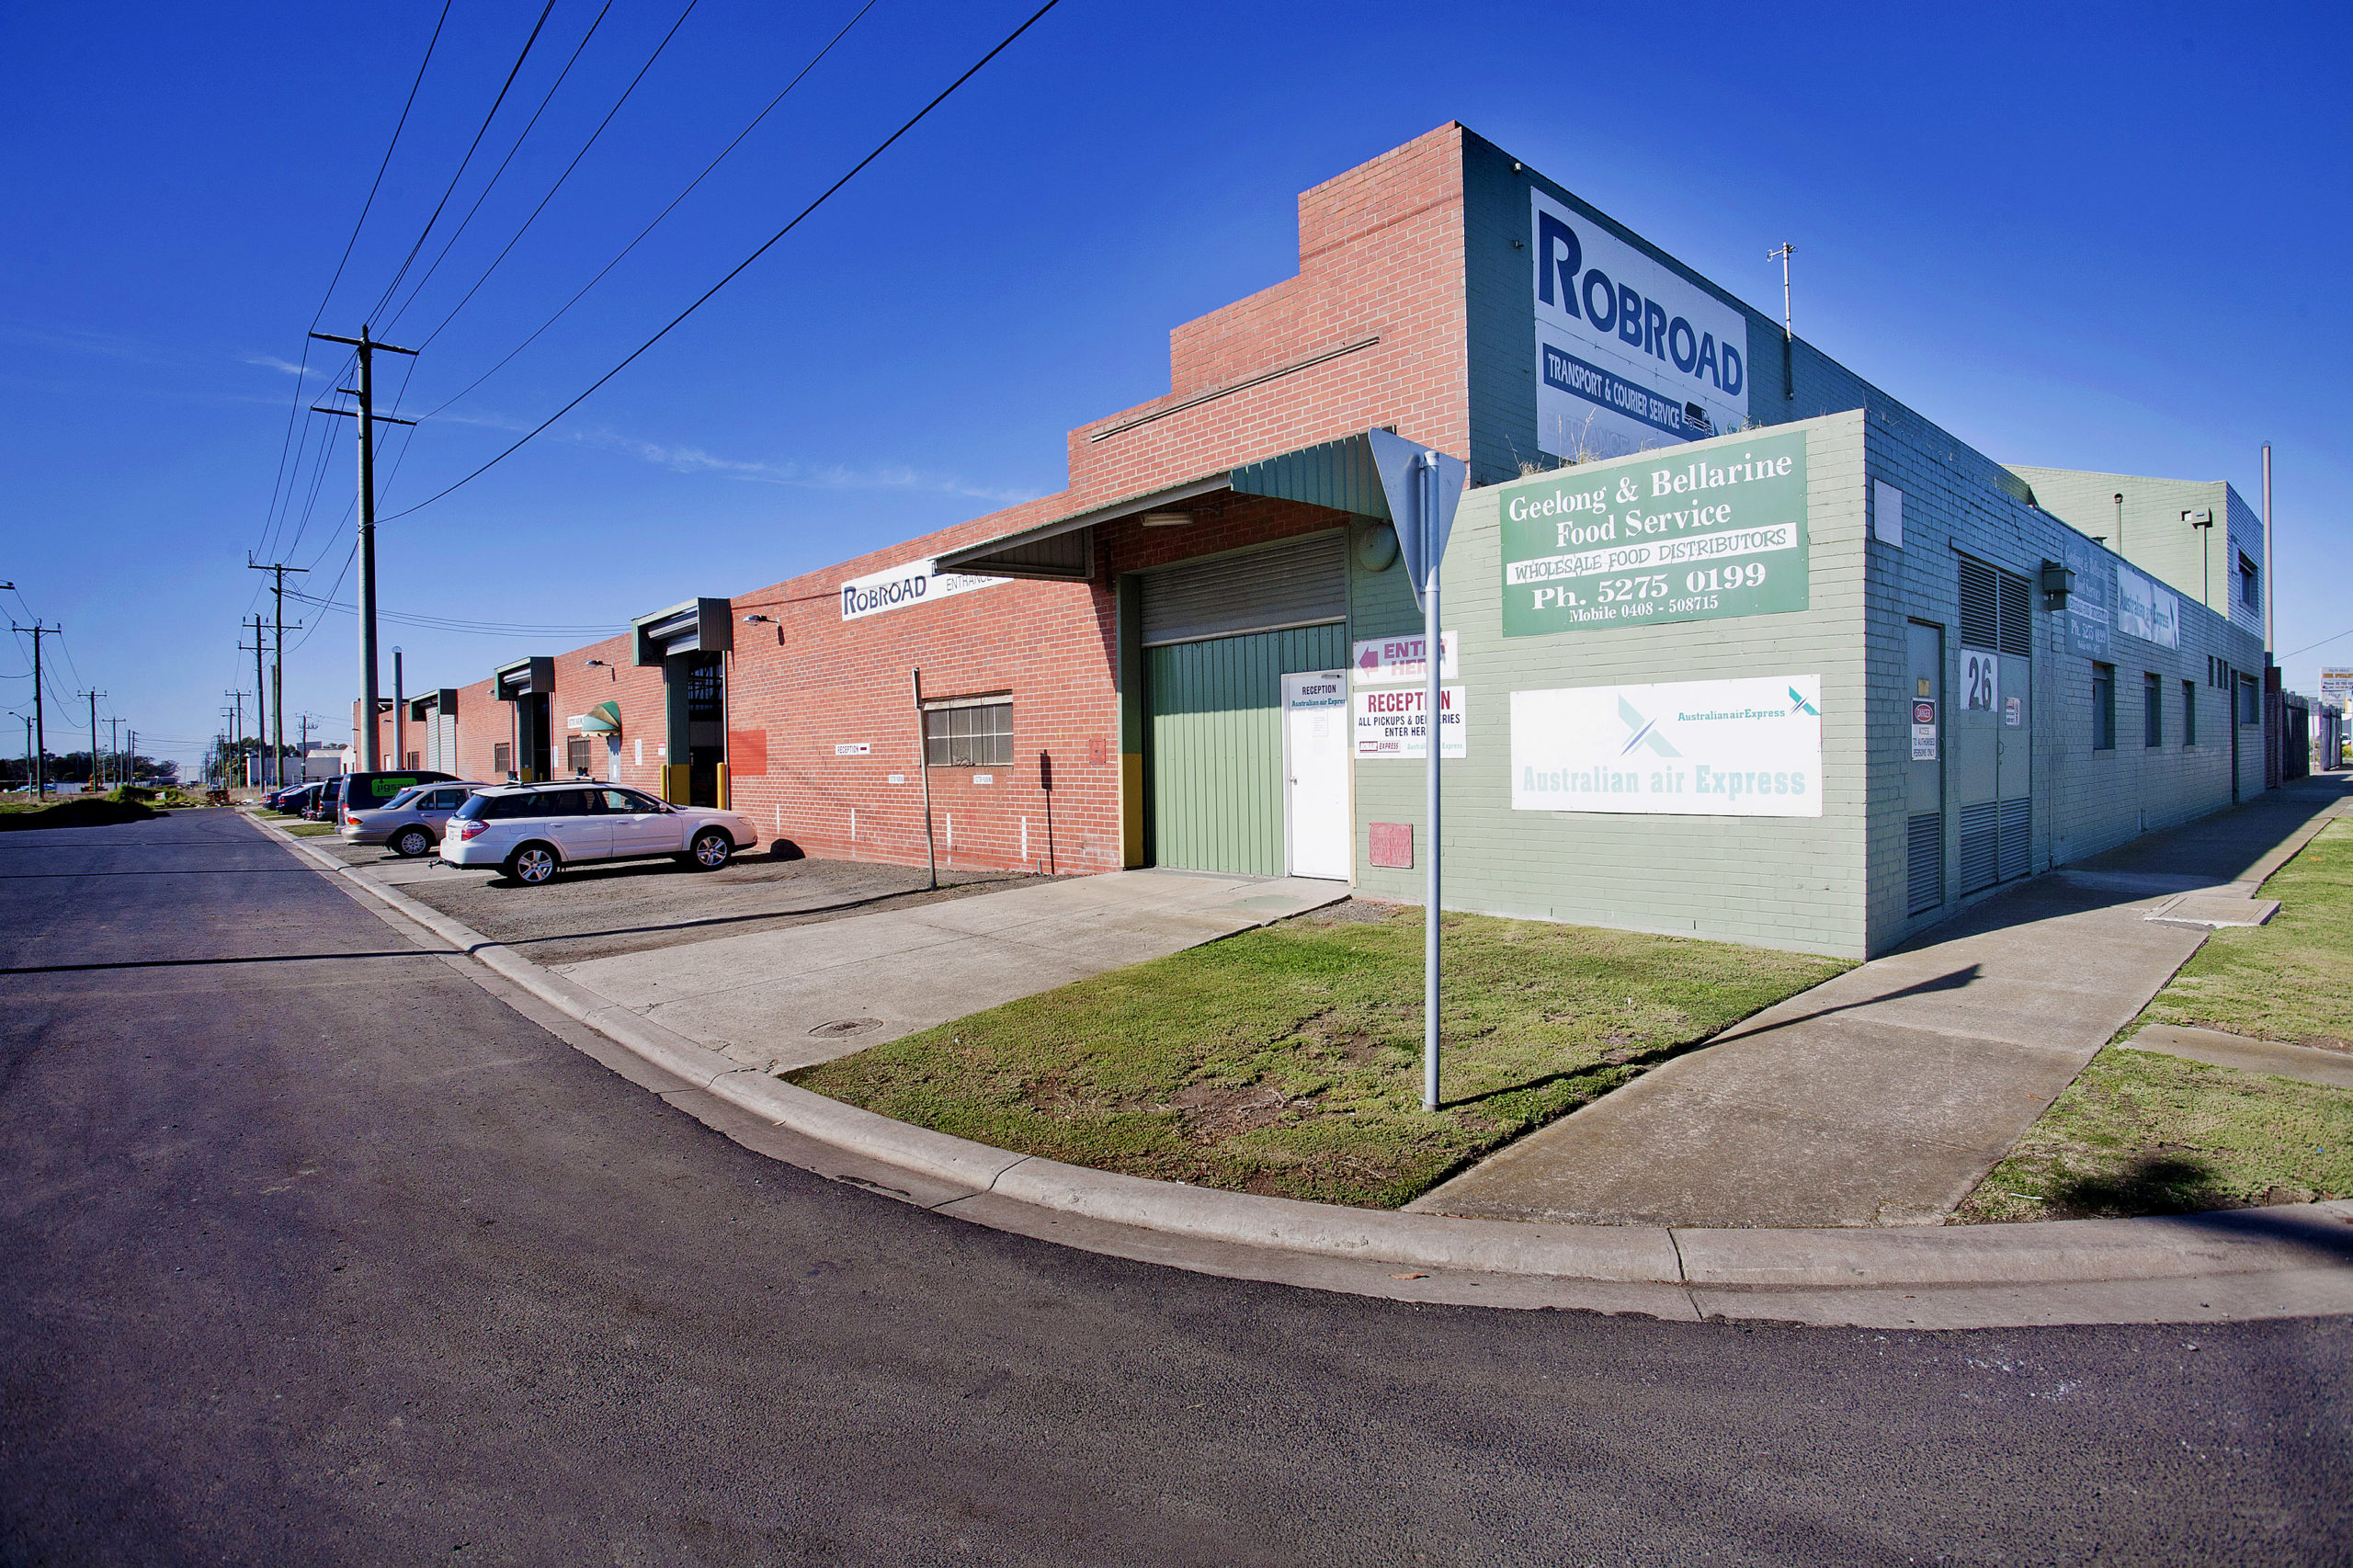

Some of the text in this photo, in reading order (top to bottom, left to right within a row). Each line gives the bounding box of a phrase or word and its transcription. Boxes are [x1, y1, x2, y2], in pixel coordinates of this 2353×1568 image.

[1539, 209, 1744, 397] ROBROAD
[1548, 353, 1680, 430] TRANSPORT & COURIER SERVICE
[1508, 452, 1792, 522] Geelong & Bellarine
[1556, 498, 1732, 548] Food Service
[1515, 528, 1787, 581] WHOLESALE FOOD DISTRIBUTORS
[844, 574, 927, 616] ROBROAD
[1531, 562, 1767, 610] Ph. 5275 0199
[1569, 606, 1618, 623] Mobile
[1620, 601, 1654, 618] 0408
[1668, 594, 1719, 613] 508715
[1291, 699, 1319, 708] Australian
[1302, 685, 1336, 695] RECEPTION
[1968, 655, 1993, 712] 26
[1358, 716, 1371, 726] ALL
[1373, 715, 1404, 726] PICKUPS
[1407, 715, 1413, 725] &
[1384, 726, 1427, 737] ENTER HER
[1379, 742, 1399, 750] EXPRESS
[1523, 764, 1806, 801] Australian air Express
